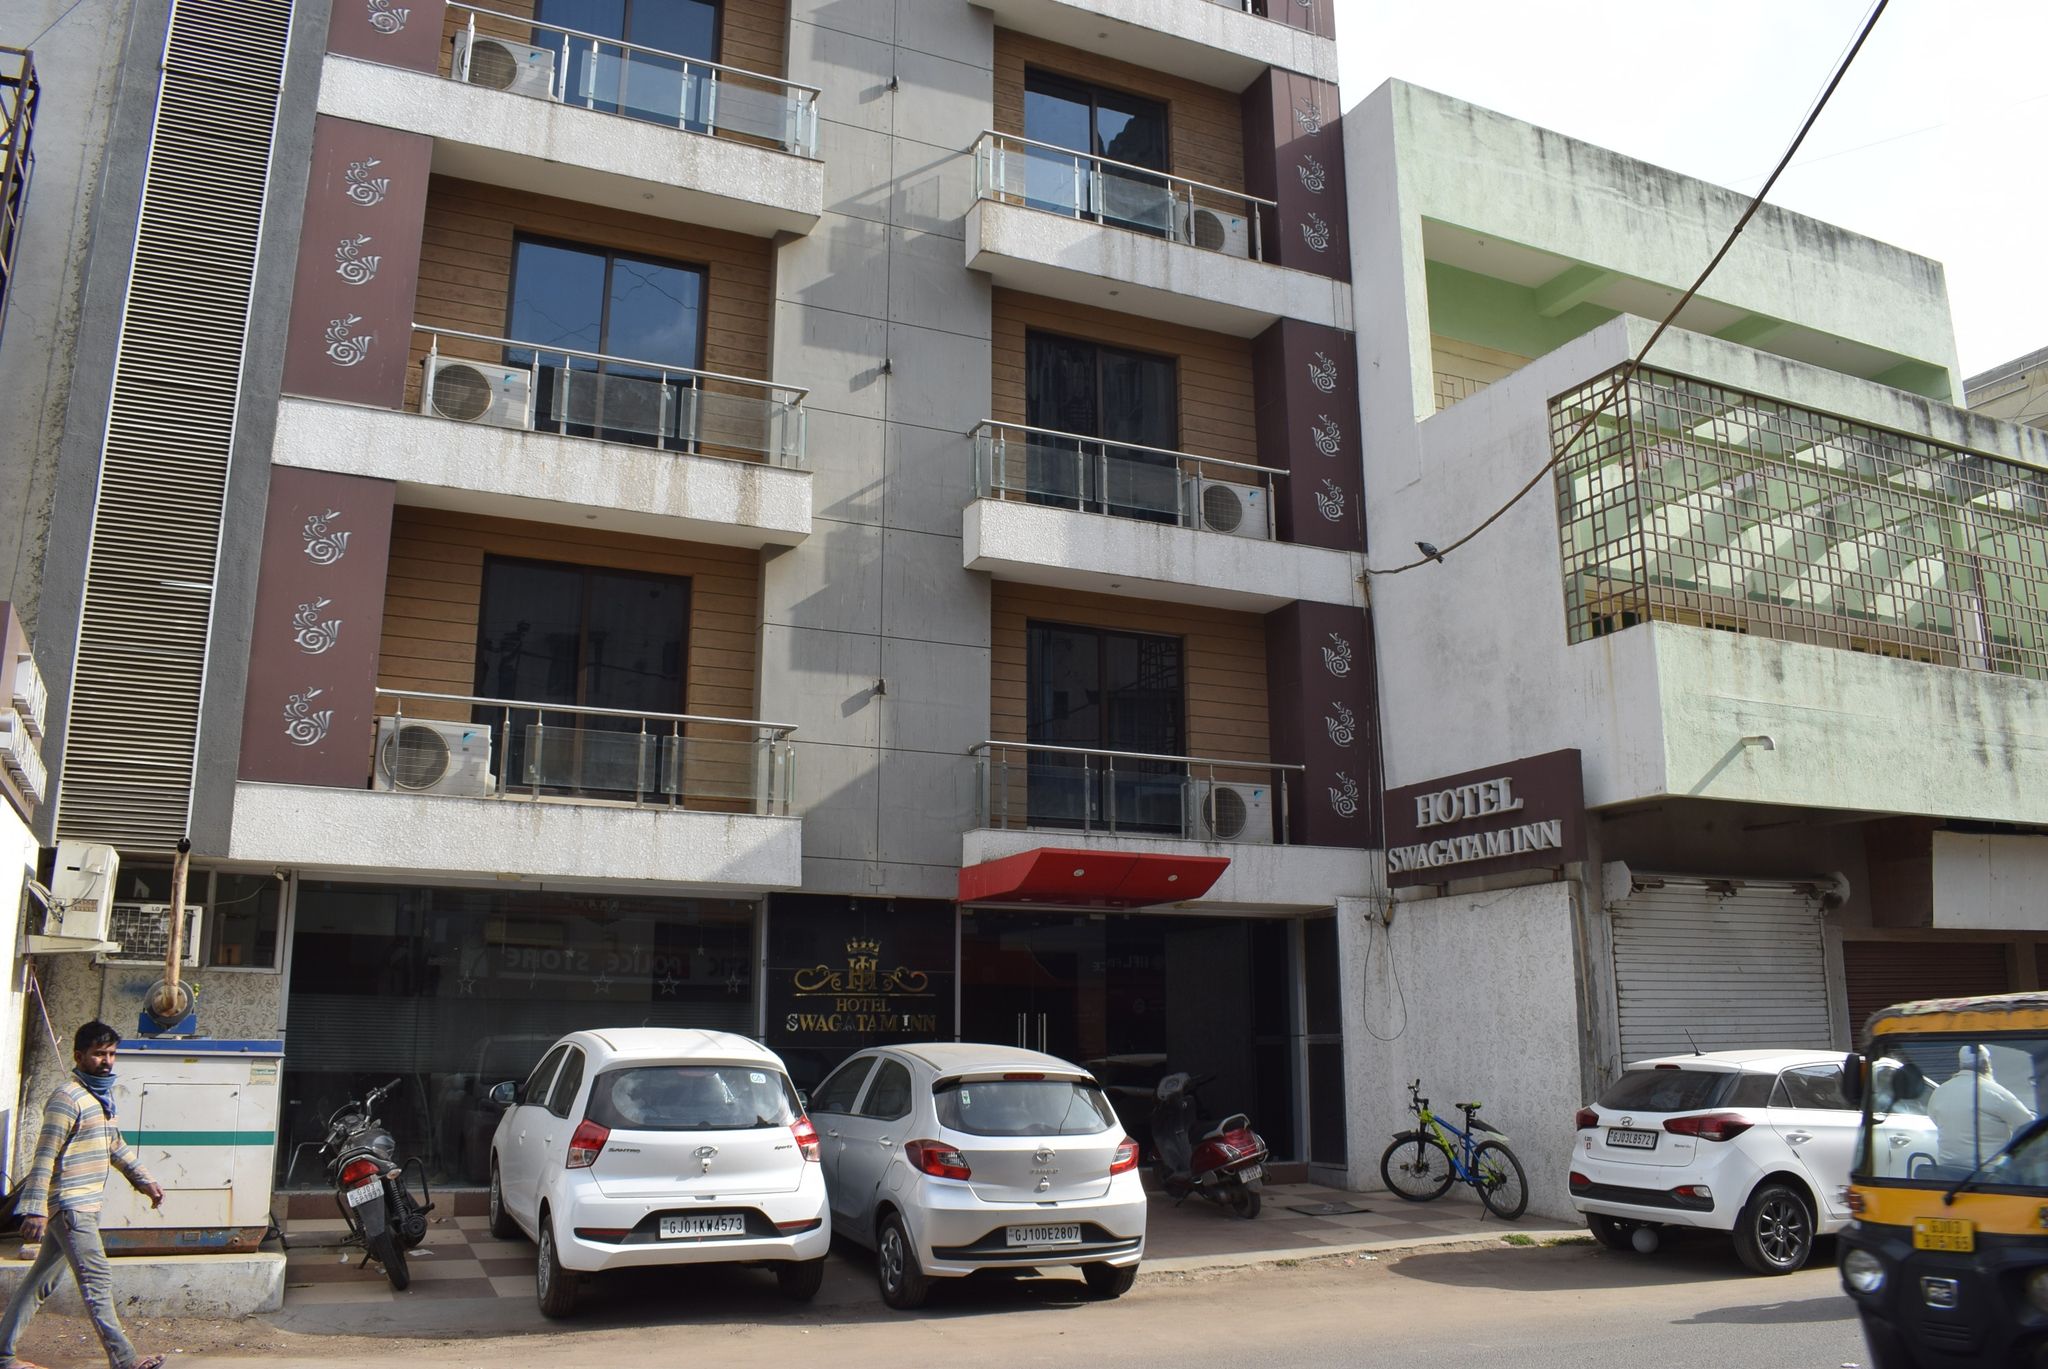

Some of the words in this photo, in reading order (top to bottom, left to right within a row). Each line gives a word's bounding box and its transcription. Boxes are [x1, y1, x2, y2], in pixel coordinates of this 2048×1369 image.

[1415, 777, 1524, 828] HOTEL
[1388, 829, 1512, 874] SWAGATAM
[1510, 819, 1563, 854] INN
[836, 998, 891, 1012] HOTEL
[785, 1013, 898, 1032] SWAGATAM
[902, 1014, 936, 1031] INN
[669, 1217, 743, 1234] GJ01KW4573
[1015, 1226, 1079, 1242] GJ10DE2807
